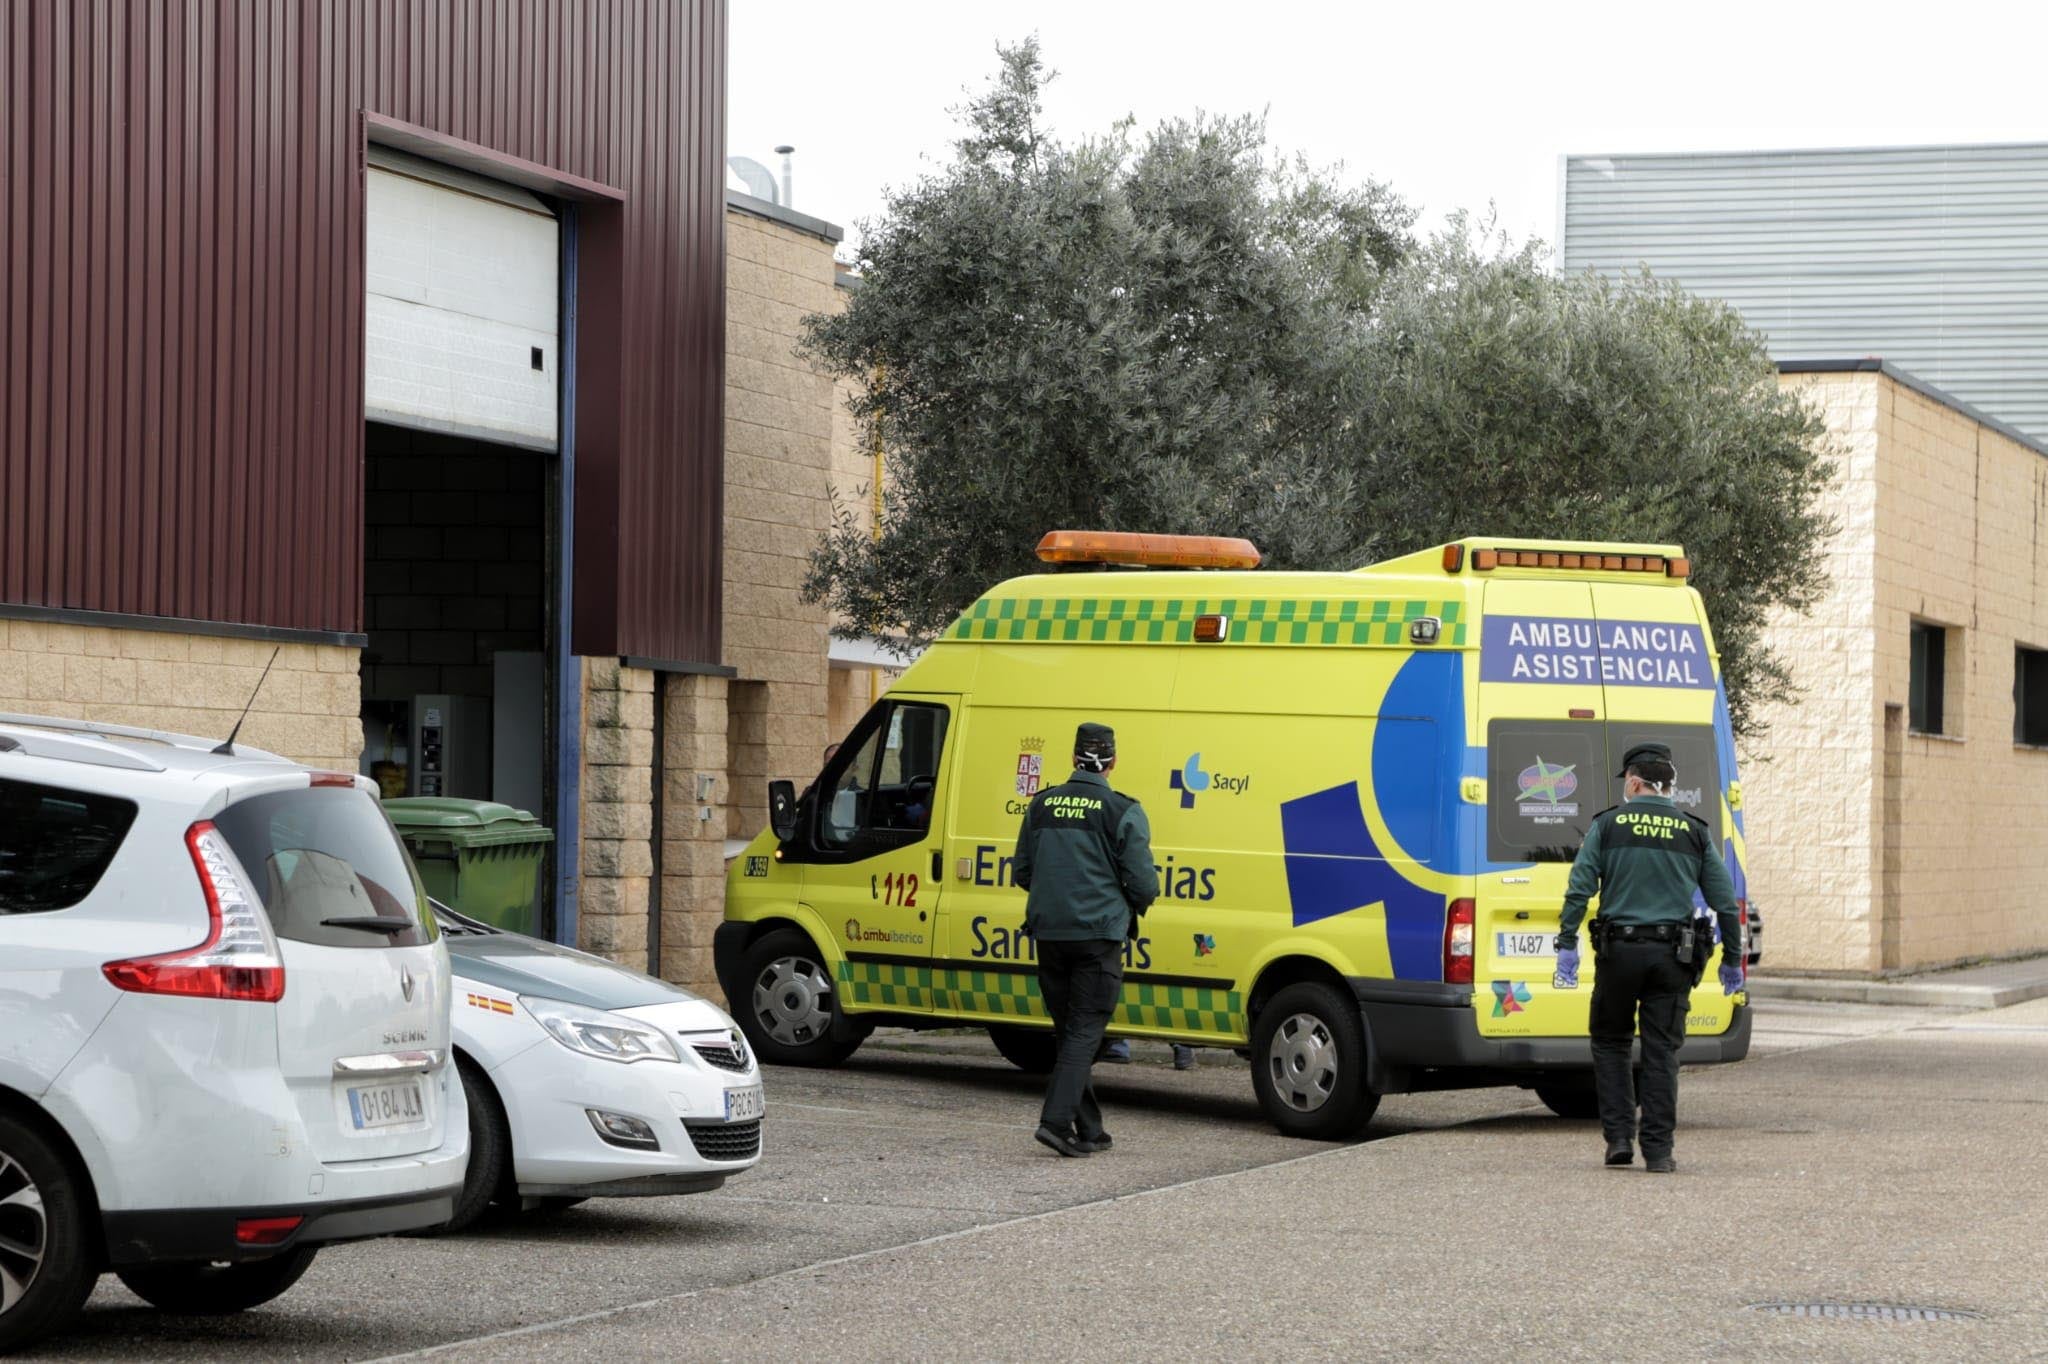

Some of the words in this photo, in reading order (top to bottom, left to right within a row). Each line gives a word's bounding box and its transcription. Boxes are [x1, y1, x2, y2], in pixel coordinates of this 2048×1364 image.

[1508, 622, 1696, 654] AMBULANCIA
[1511, 653, 1699, 685] ASISTENCIAL
[1212, 773, 1249, 795] Sacyl
[1044, 796, 1102, 810] GUARDIA
[1053, 807, 1086, 819] CIVIL
[1615, 813, 1690, 832] GUARDIA
[1632, 824, 1674, 839] CIVIL
[884, 872, 919, 907] 112
[1511, 936, 1544, 954] 1487
[383, 1030, 428, 1044] SCENIC
[361, 1089, 400, 1121] 0184
